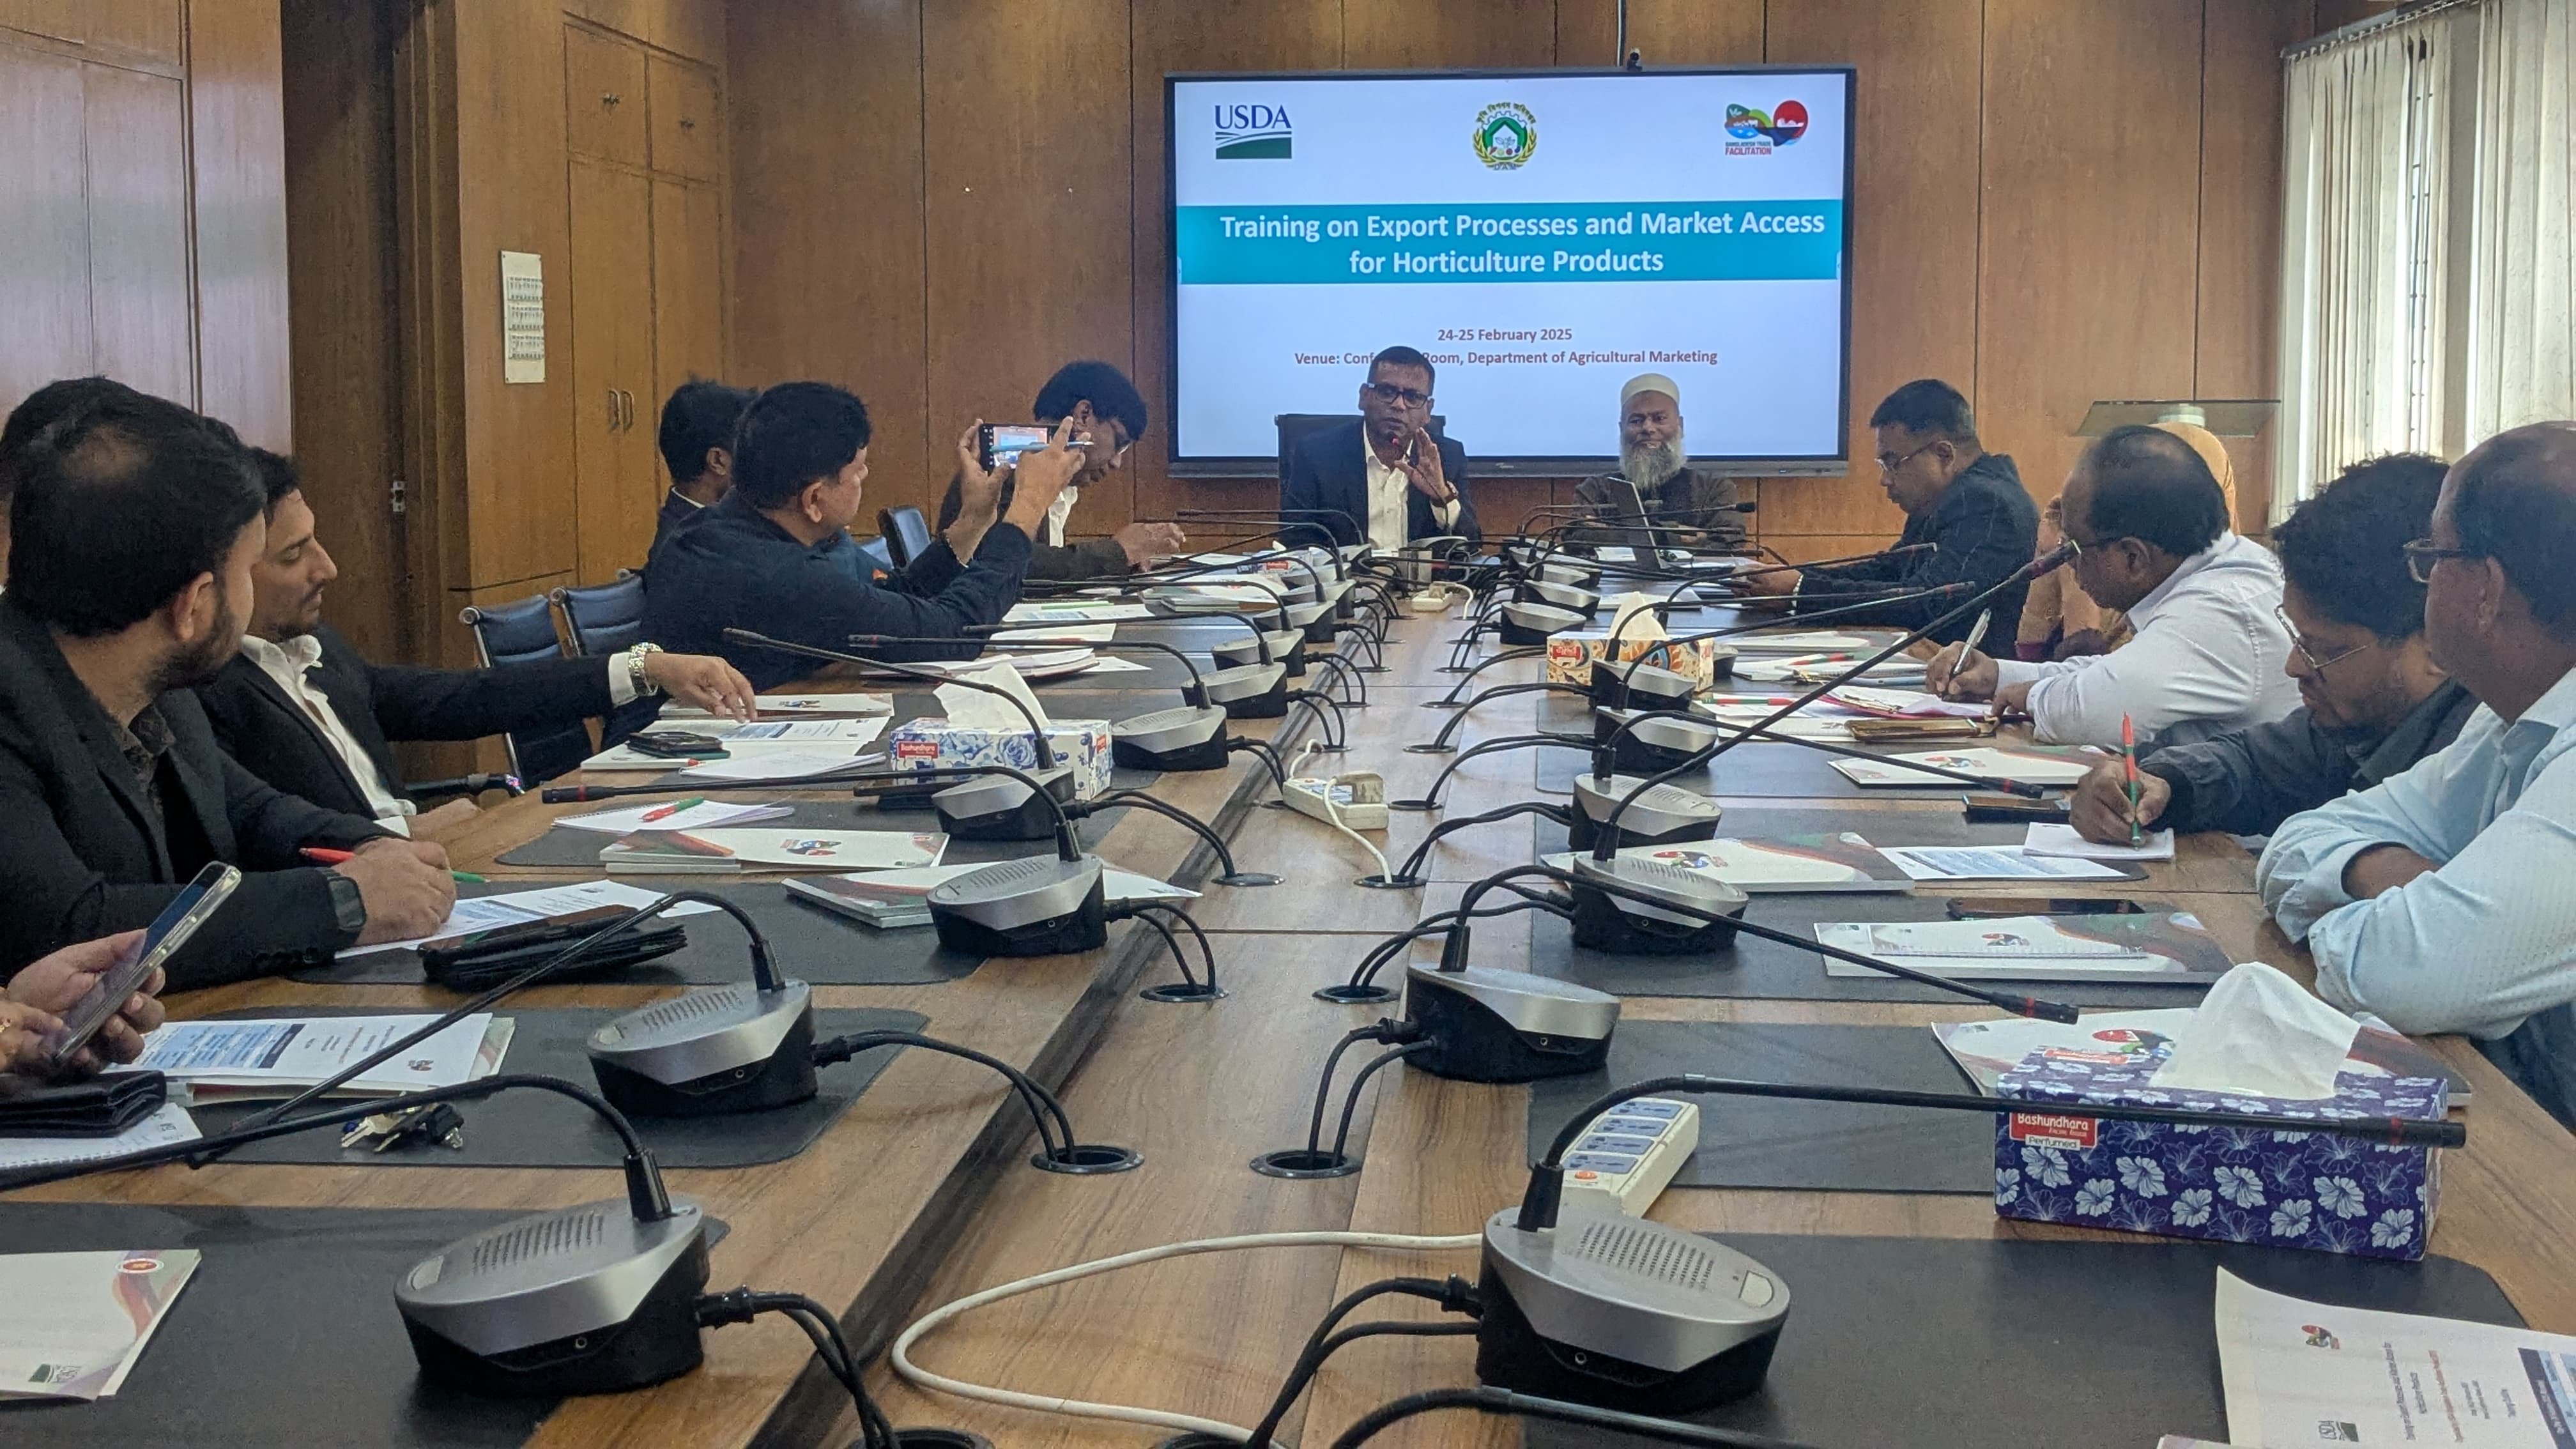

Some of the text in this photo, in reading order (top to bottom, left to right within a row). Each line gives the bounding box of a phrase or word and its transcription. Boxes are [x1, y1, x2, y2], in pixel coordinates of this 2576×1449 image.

[1215, 104, 1292, 128] USDA
[1726, 147, 1772, 155] FACILITATION
[1220, 211, 1825, 243] Training on Export Processes and Market Access
[1349, 249, 1664, 274] for Horticulture Products
[1438, 328, 1572, 343] 24-25 February 2025
[1294, 352, 1340, 364] Venue:
[1468, 351, 1547, 366] Department
[1551, 351, 1566, 364] of
[1568, 351, 1645, 366] Agricultural
[1649, 350, 1717, 365] Marketing
[2017, 1113, 2089, 1130] Bashundhara
[2028, 1136, 2077, 1148] Perfumed
